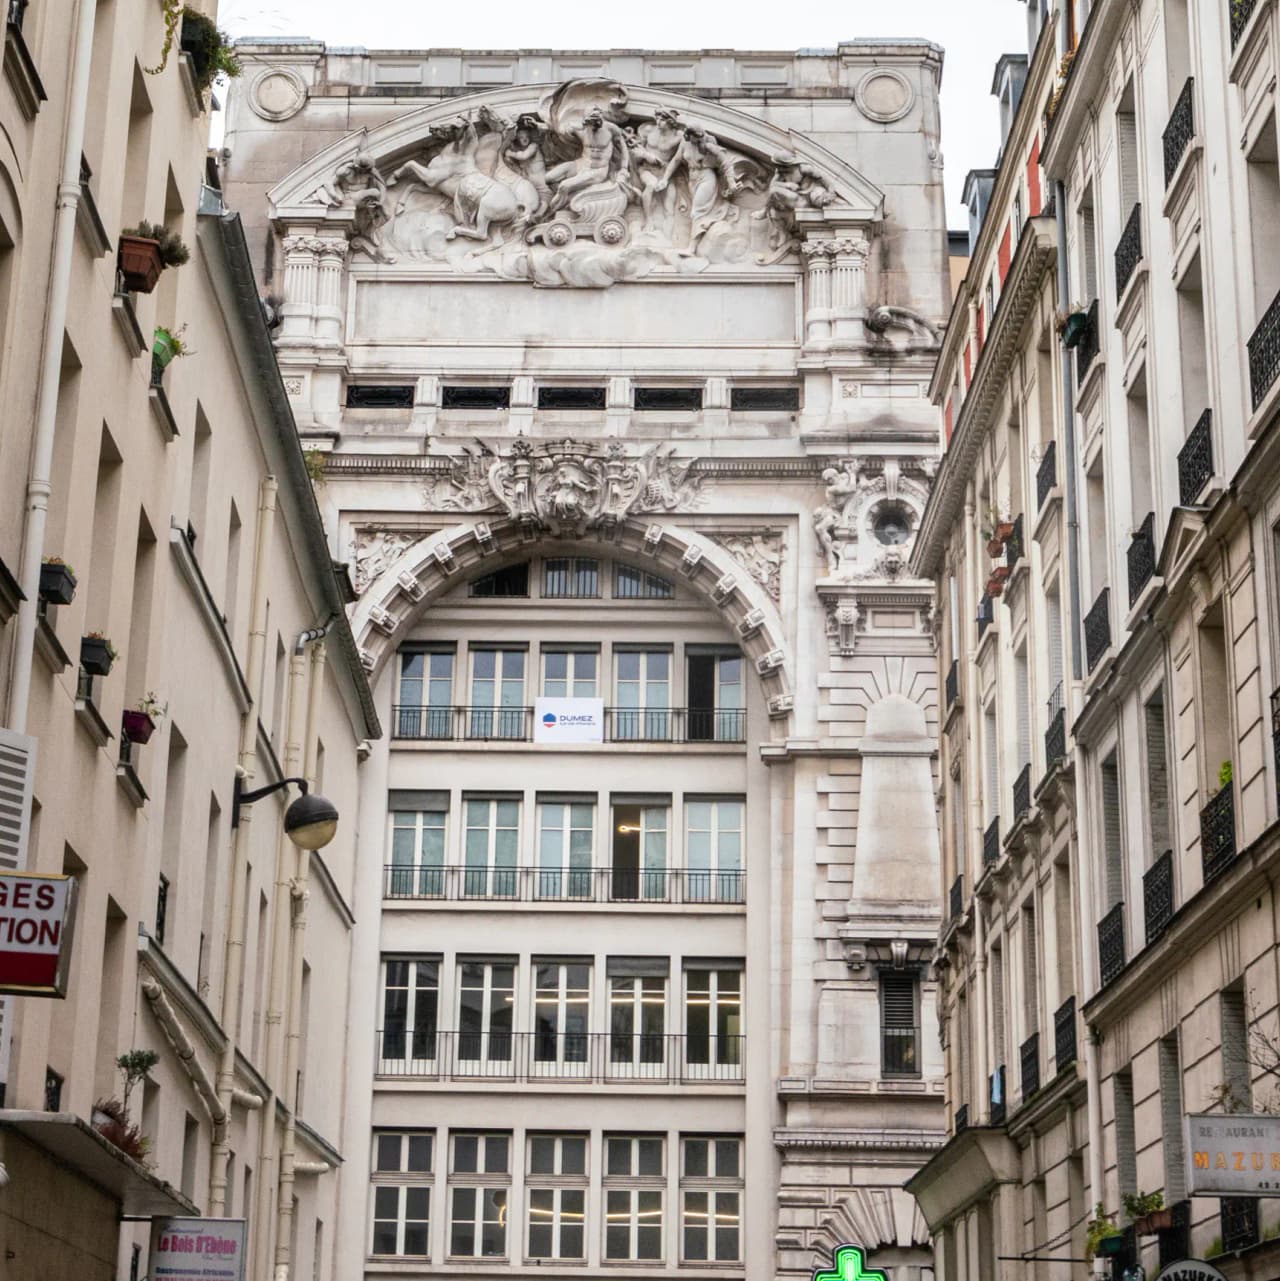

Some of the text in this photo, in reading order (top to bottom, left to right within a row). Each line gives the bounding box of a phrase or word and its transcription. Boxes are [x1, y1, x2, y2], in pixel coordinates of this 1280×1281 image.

[559, 714, 593, 722] DUMEZ
[158, 1234, 169, 1252] Le
[170, 1233, 195, 1254] Bois
